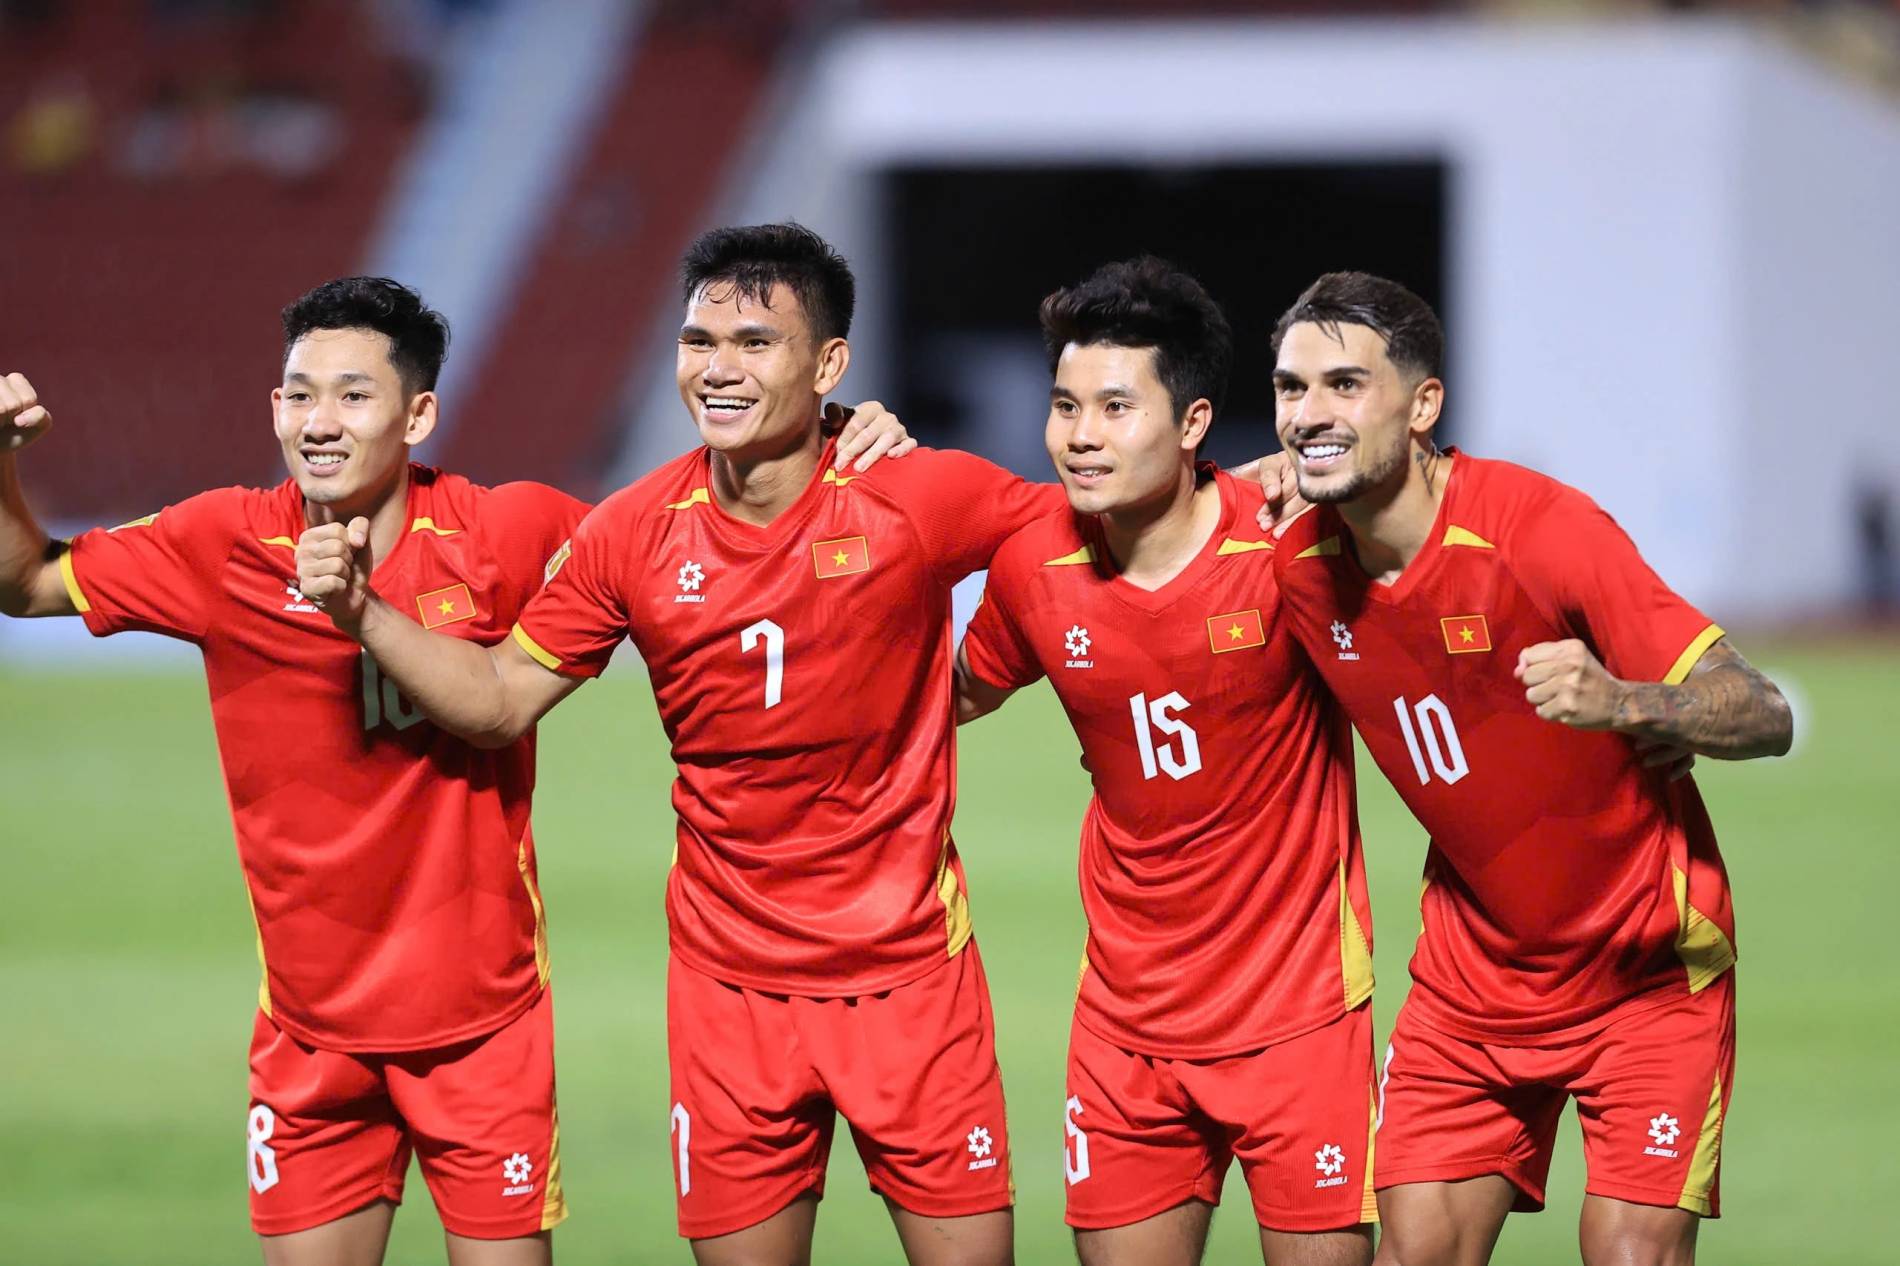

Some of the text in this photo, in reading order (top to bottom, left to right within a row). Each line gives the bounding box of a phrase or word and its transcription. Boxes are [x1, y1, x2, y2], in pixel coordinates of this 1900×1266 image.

[741, 619, 785, 710] 7
[1130, 691, 1201, 781] 15
[1394, 694, 1469, 786] 10
